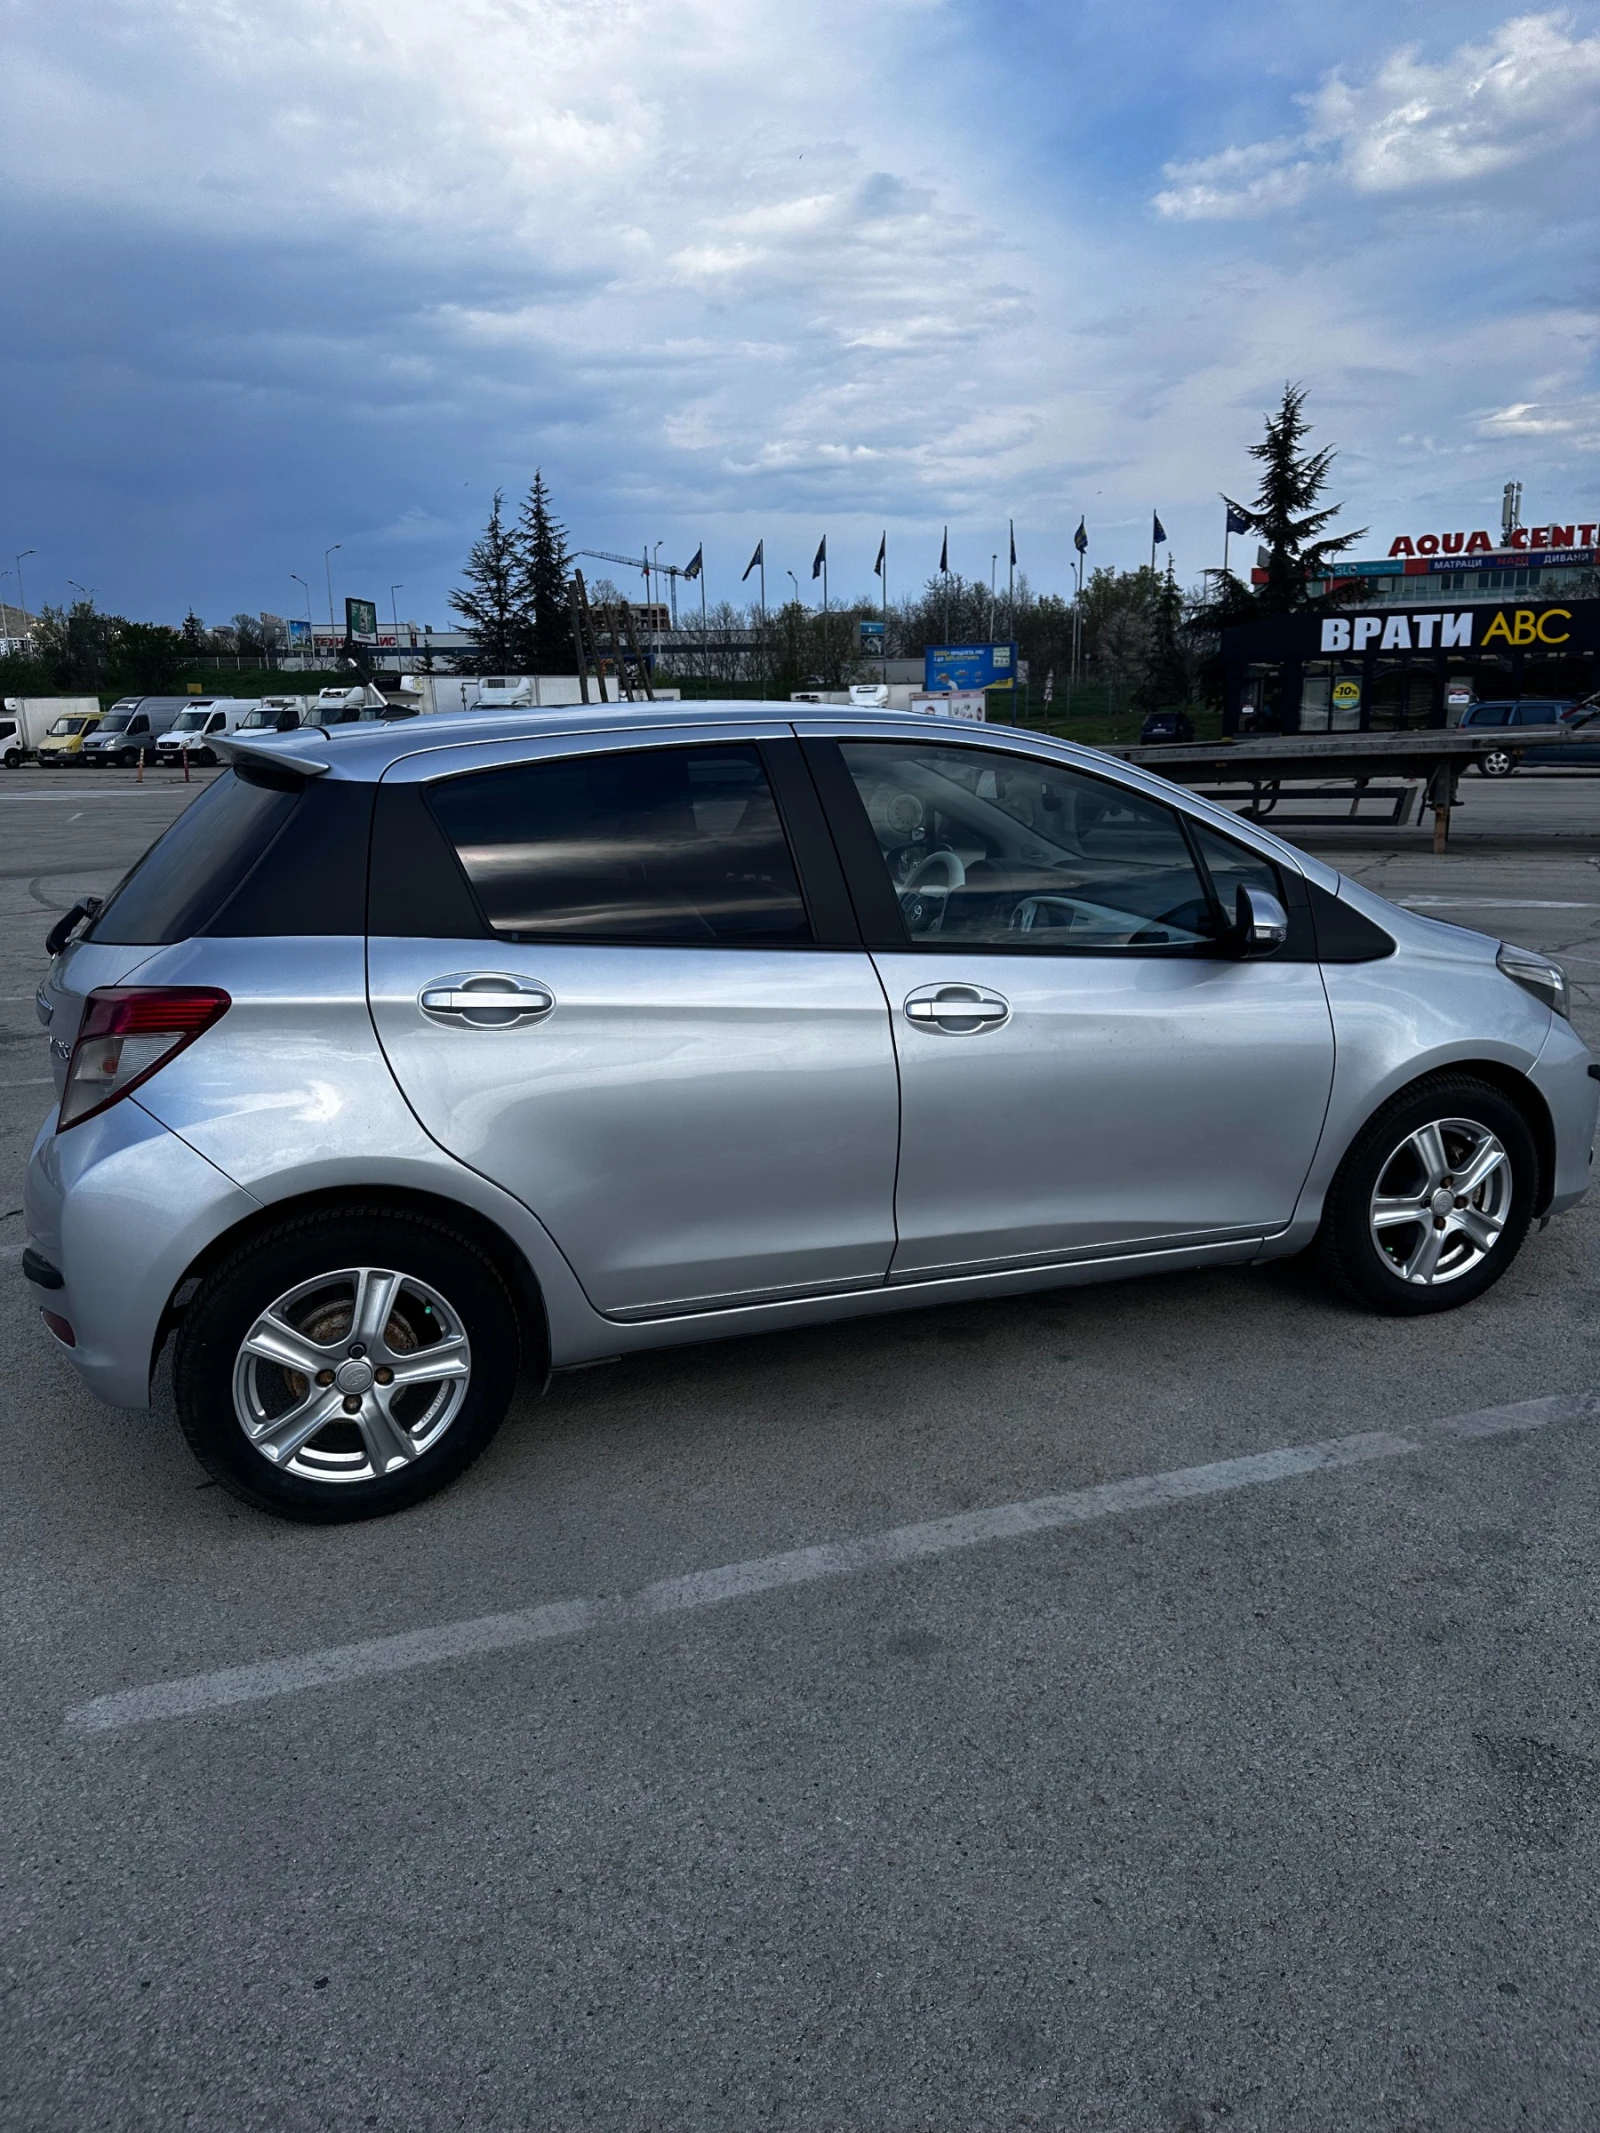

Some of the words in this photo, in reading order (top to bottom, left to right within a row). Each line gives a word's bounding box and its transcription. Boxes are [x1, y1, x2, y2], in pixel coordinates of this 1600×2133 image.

[1388, 531, 1493, 557] AQUA
[1510, 523, 1600, 549] CENT
[1433, 559, 1483, 570] МАТРАЦИ
[1496, 556, 1529, 565] NANI
[1543, 552, 1589, 565] ДИВАНИ
[1320, 612, 1474, 652] ВРАТИ
[1480, 608, 1573, 647] ABC
[314, 636, 396, 647] ТЕХНИС
[1334, 686, 1359, 696] -10%
